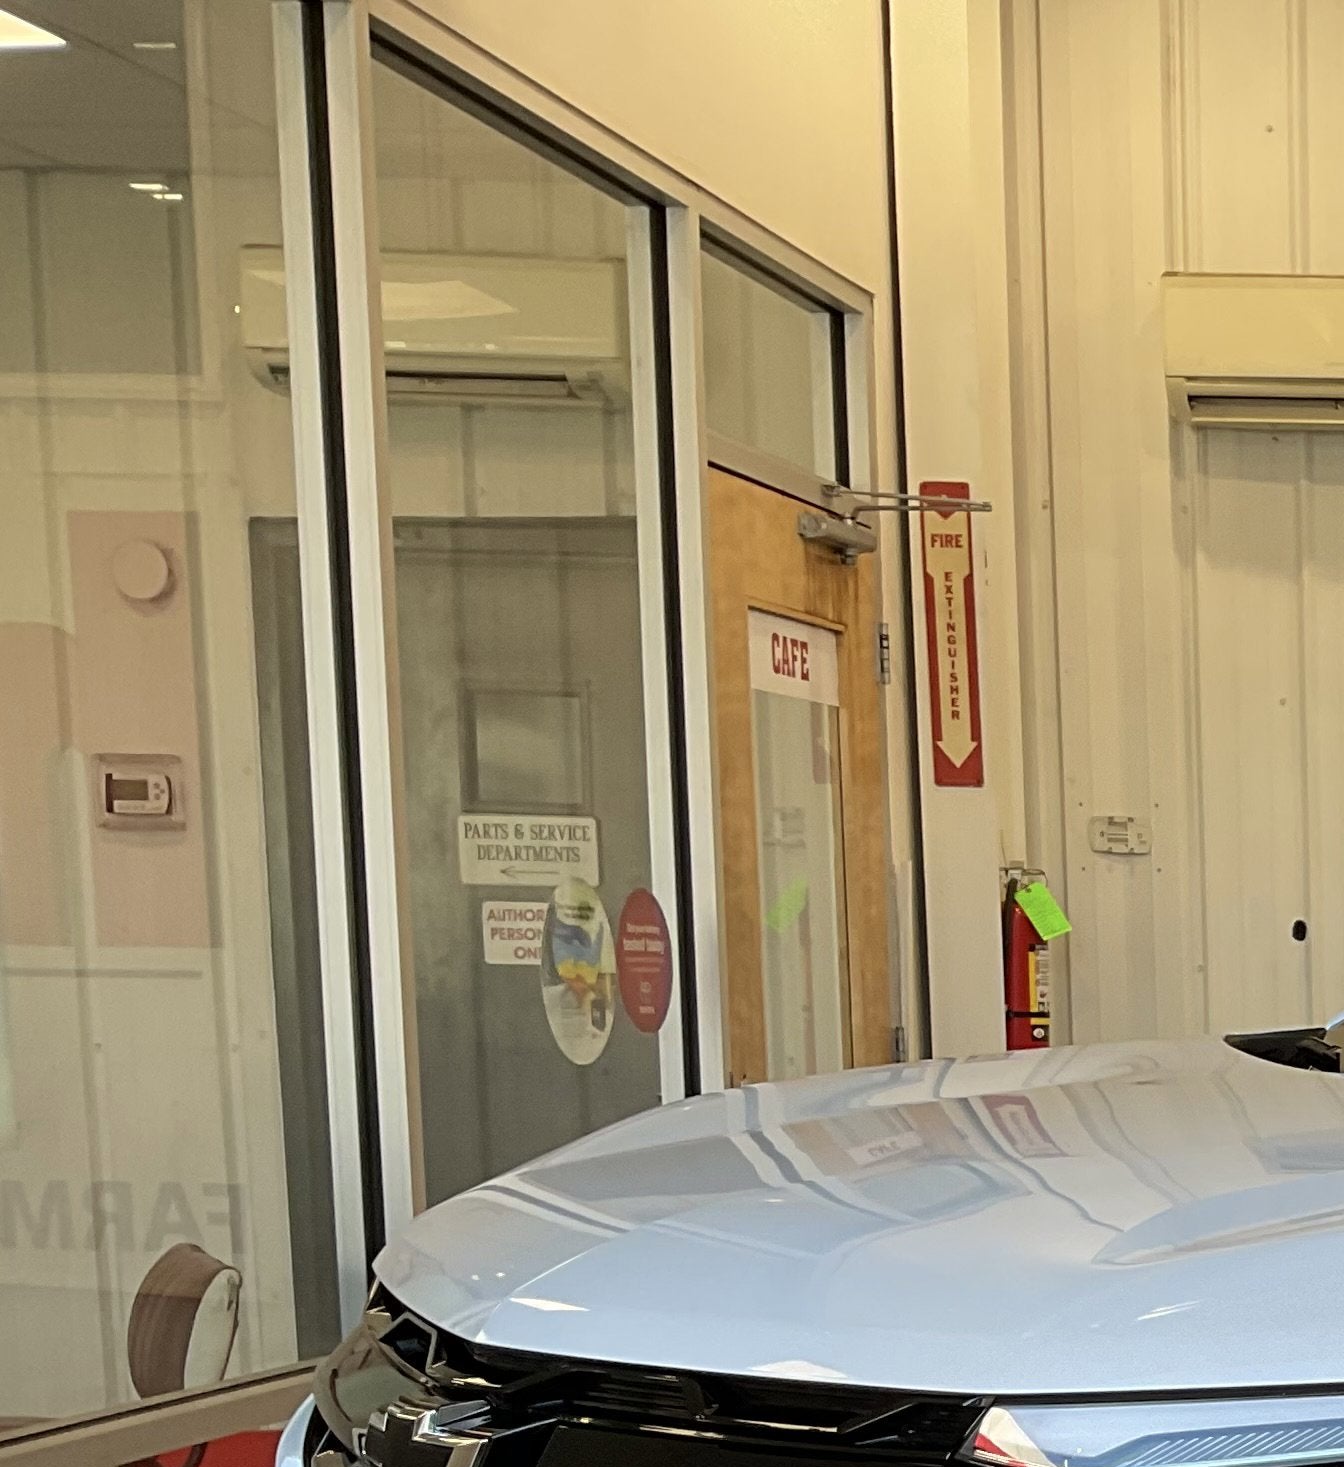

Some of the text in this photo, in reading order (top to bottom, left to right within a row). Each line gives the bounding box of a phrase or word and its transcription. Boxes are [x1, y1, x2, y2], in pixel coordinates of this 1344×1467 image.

[930, 533, 963, 549] FIRE
[944, 571, 960, 720] EXTINGUISHER
[770, 632, 810, 682] CAFE
[463, 822, 591, 842] PARTS & SERVICE
[476, 844, 582, 863] DEPARTMENTS
[513, 946, 542, 960] ON
